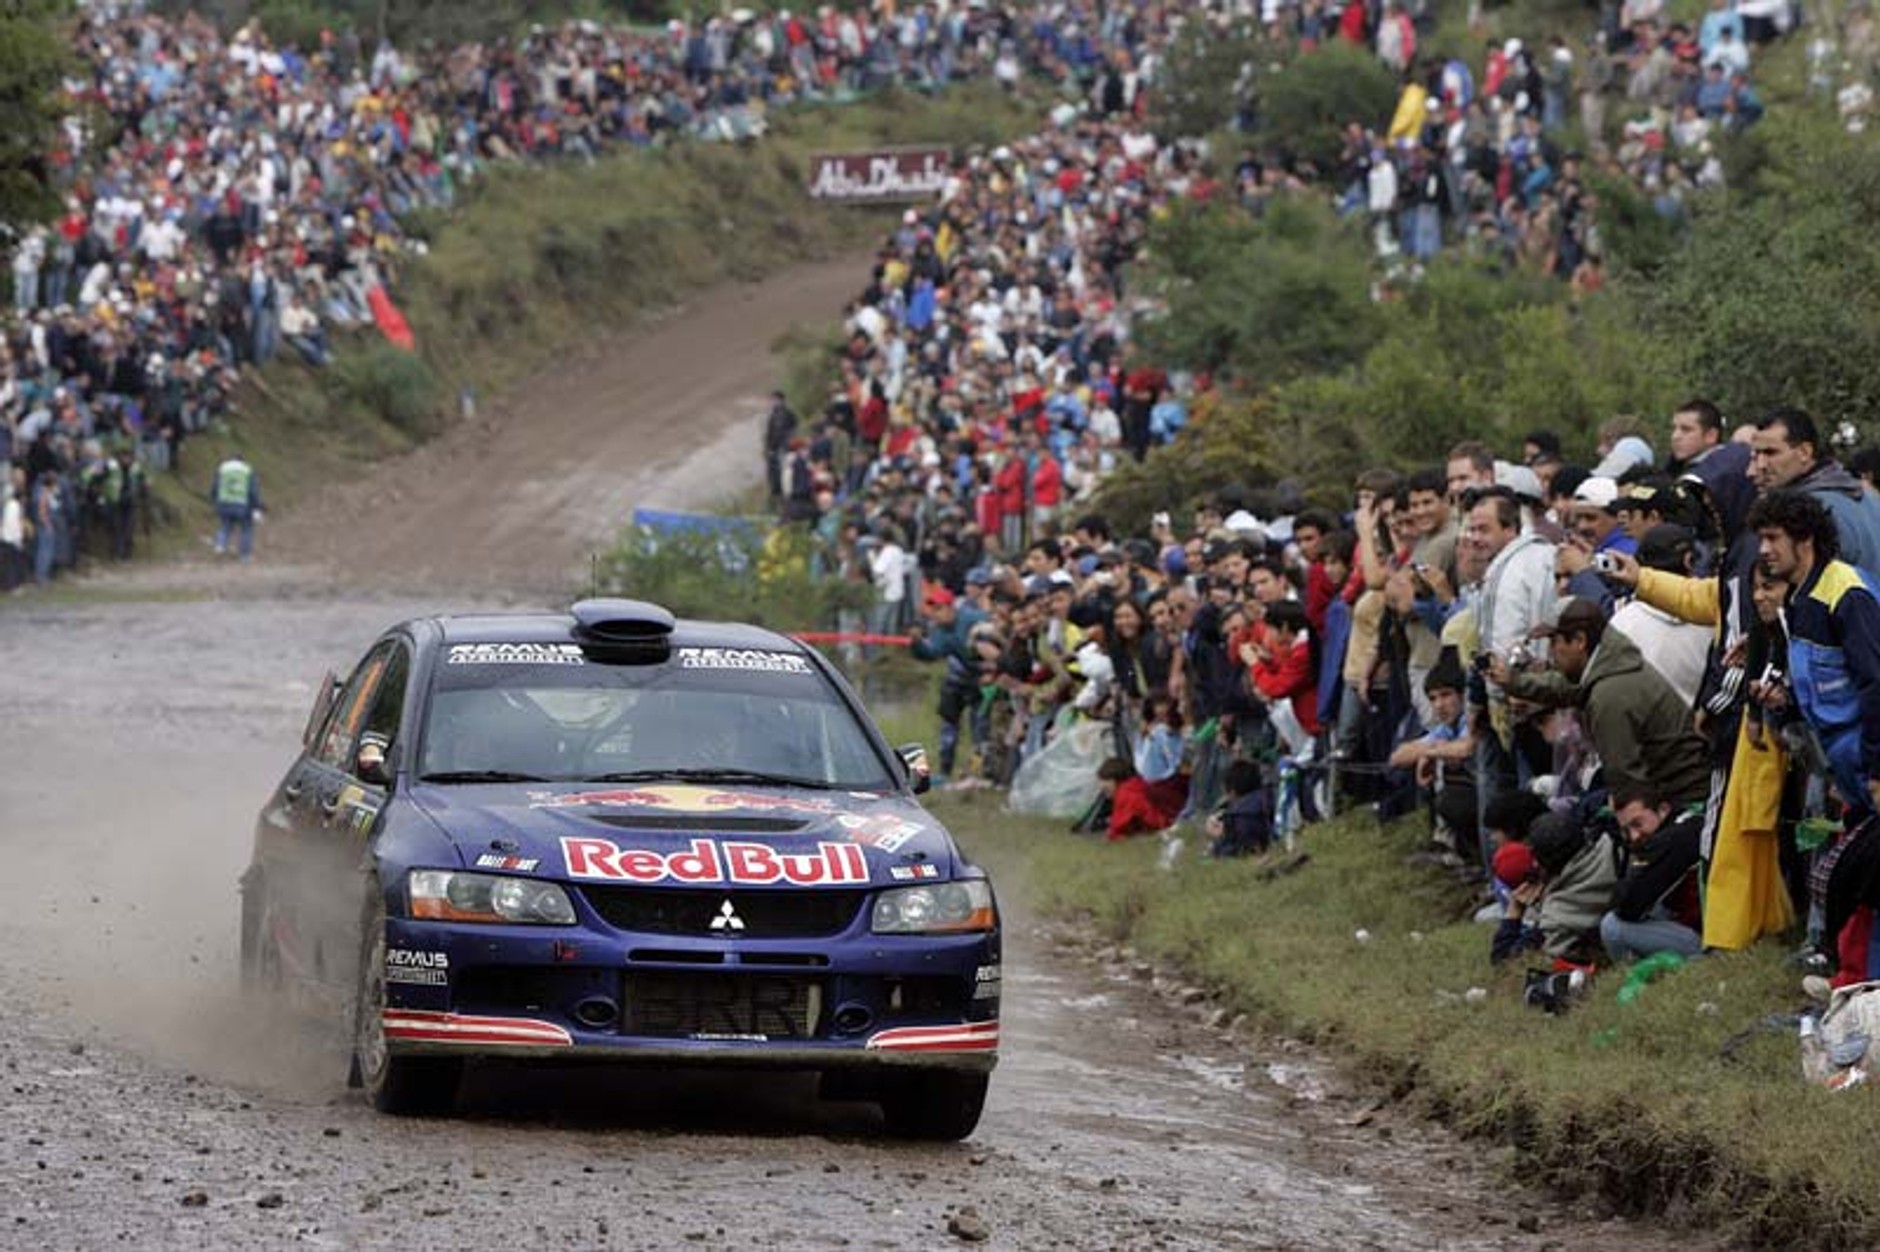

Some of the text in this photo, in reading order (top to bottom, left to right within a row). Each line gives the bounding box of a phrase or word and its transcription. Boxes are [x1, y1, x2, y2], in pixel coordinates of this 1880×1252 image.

[562, 838, 868, 883] Red Bull
[384, 949, 448, 968] REMUS
